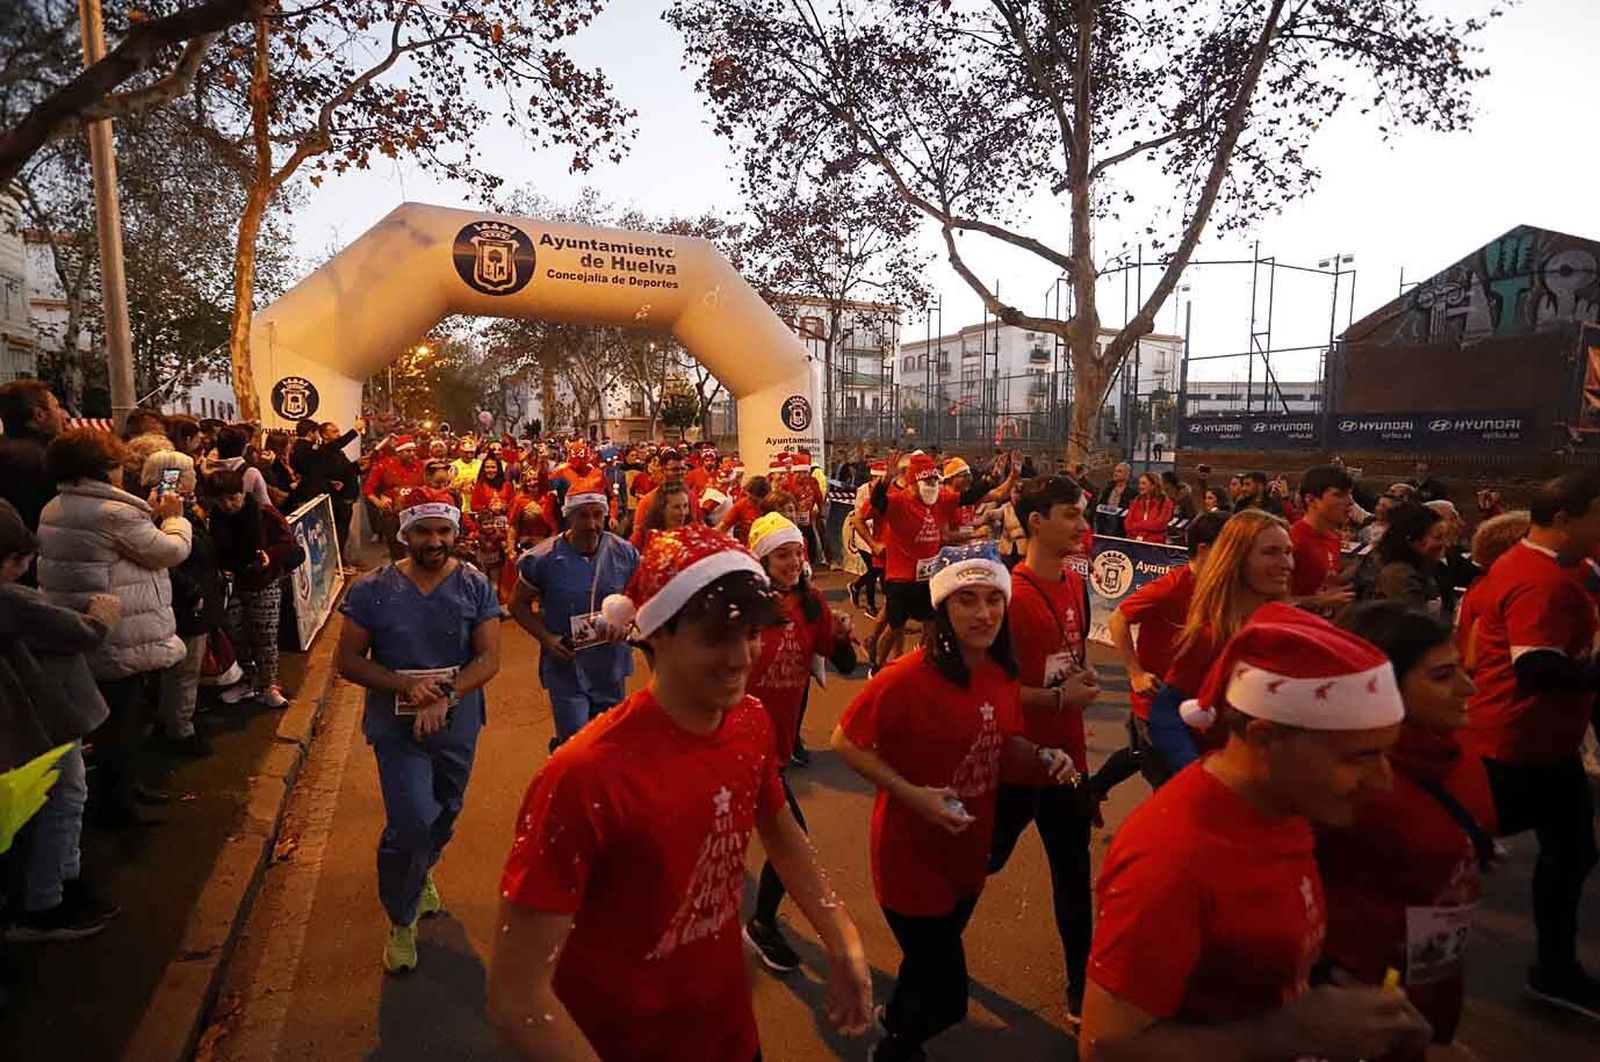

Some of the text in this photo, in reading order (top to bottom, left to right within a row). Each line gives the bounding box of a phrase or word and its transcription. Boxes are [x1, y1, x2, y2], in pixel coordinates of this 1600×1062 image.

[540, 233, 675, 259] Ayuntamiento
[580, 254, 677, 275] de Huelva
[611, 274, 625, 285] de
[630, 276, 679, 290] Deportes
[1204, 424, 1242, 432] HYUNDAI
[1269, 422, 1314, 432] HYUNDAI
[1359, 420, 1413, 431] HYUNDAI
[1454, 419, 1521, 431] HYUNDAI
